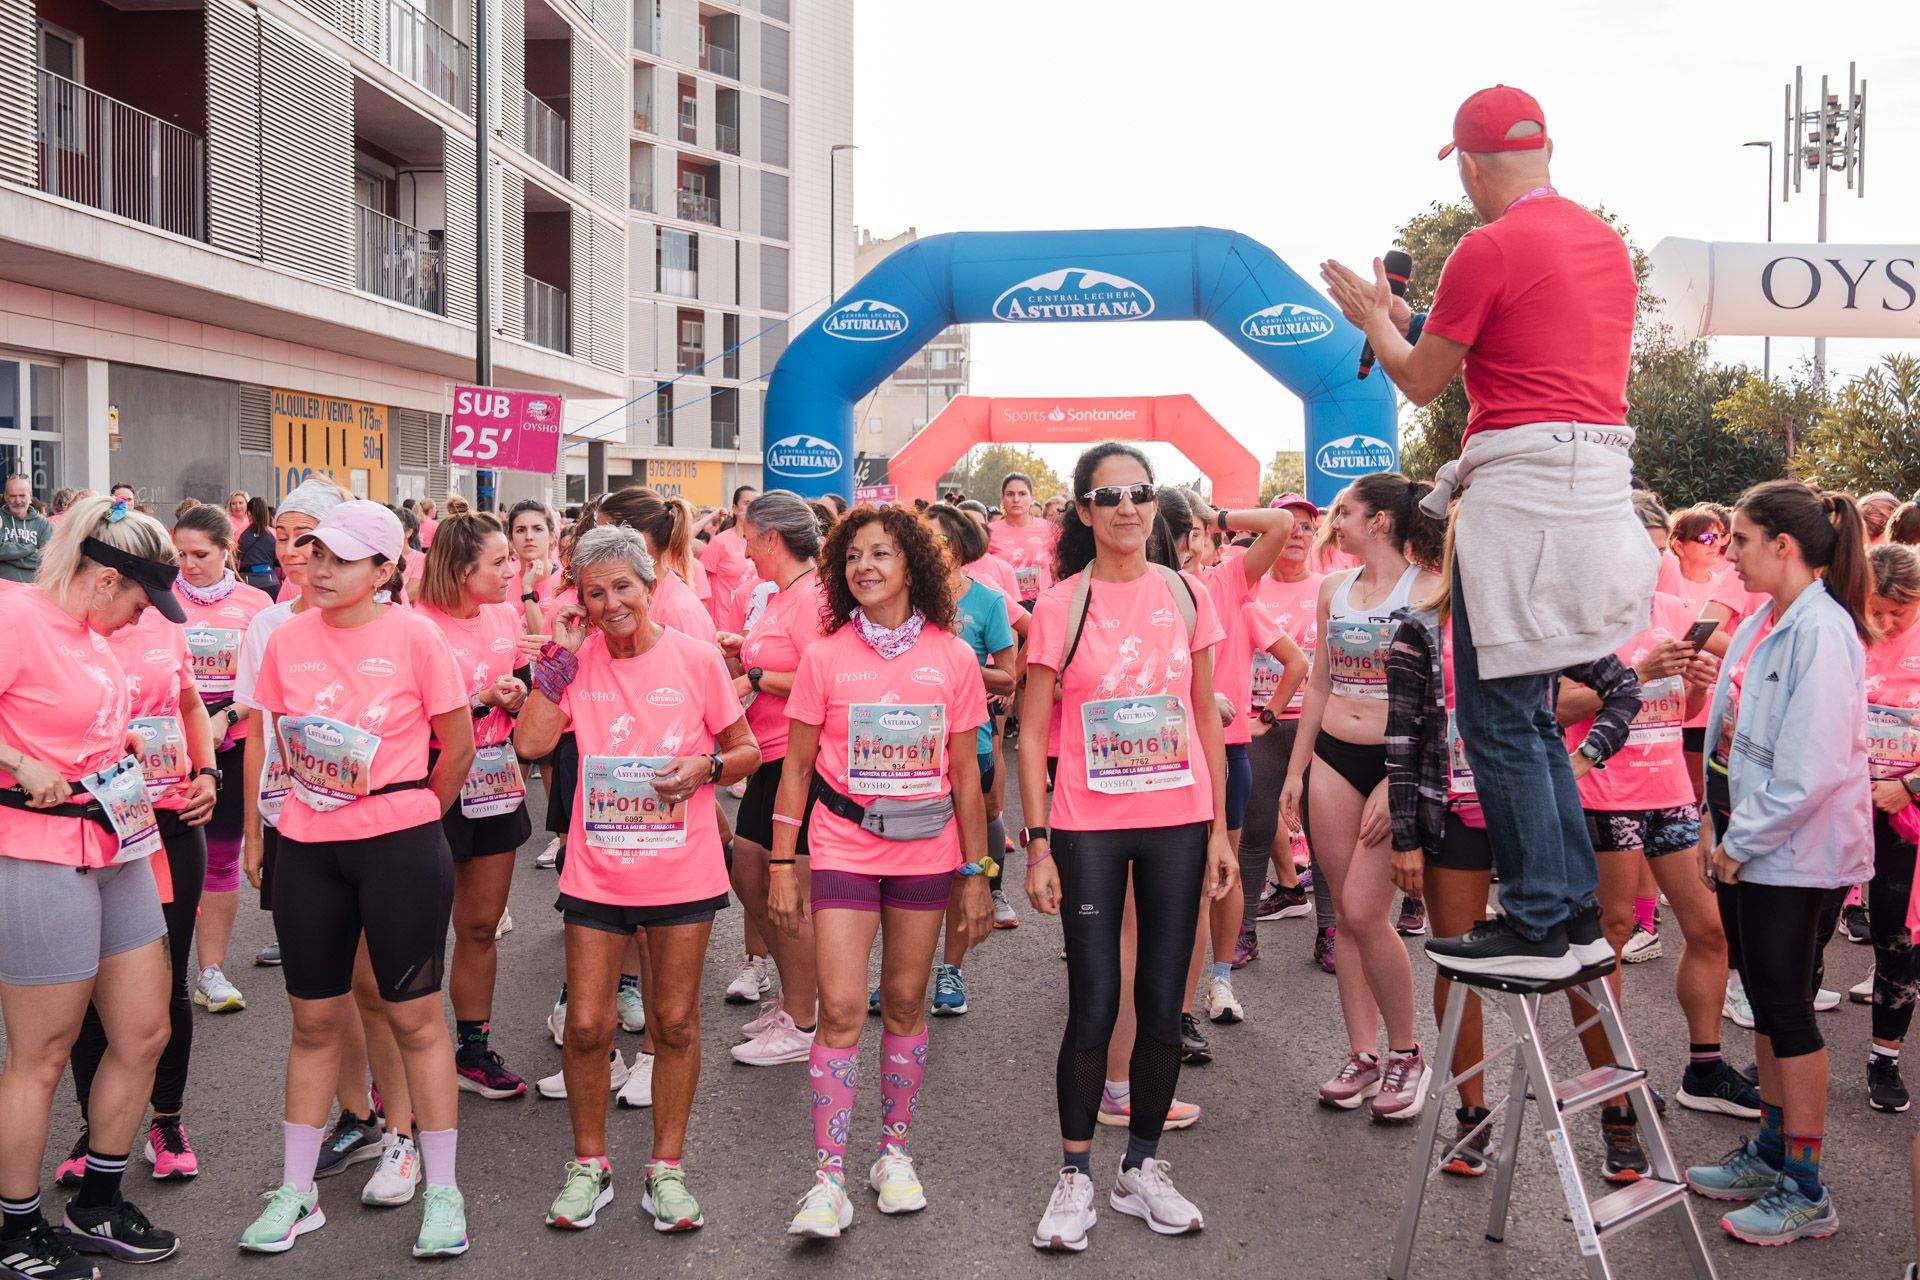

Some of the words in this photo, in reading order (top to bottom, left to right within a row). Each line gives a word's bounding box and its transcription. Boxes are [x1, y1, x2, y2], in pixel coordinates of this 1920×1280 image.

[1761, 256, 1917, 312] OYS
[1029, 293, 1079, 303] CENTRAL
[1084, 291, 1136, 301] LECHERA
[1006, 298, 1143, 319] ASTURIANA
[828, 315, 902, 331] ASTURIANA
[1249, 320, 1328, 337] ASTURIANA
[275, 392, 320, 419] ALQUILER
[327, 400, 354, 423] VENTA
[457, 391, 511, 418] SUB
[1003, 402, 1047, 425] Sports
[1067, 404, 1138, 421] Santander
[522, 422, 558, 433] OYSHO
[770, 450, 838, 468] ASTURIANA
[1321, 451, 1391, 468] ASTURIANA
[649, 483, 682, 499] OCAL
[856, 488, 878, 499] SUB
[1344, 655, 1371, 669] 016
[835, 671, 878, 685] OYSHO
[1641, 699, 1669, 713] 016
[881, 717, 919, 726] ASTURIANA
[882, 744, 919, 759] 016
[1120, 737, 1159, 755] 016
[141, 753, 162, 769] 16
[305, 755, 339, 777] 016
[1130, 757, 1150, 766] 7762
[485, 771, 507, 785] 016
[859, 781, 891, 790] OYSHO
[1100, 779, 1133, 788] OYSHO
[616, 796, 655, 812] 016
[624, 815, 644, 823] 6092
[595, 834, 625, 843] OYSHO
